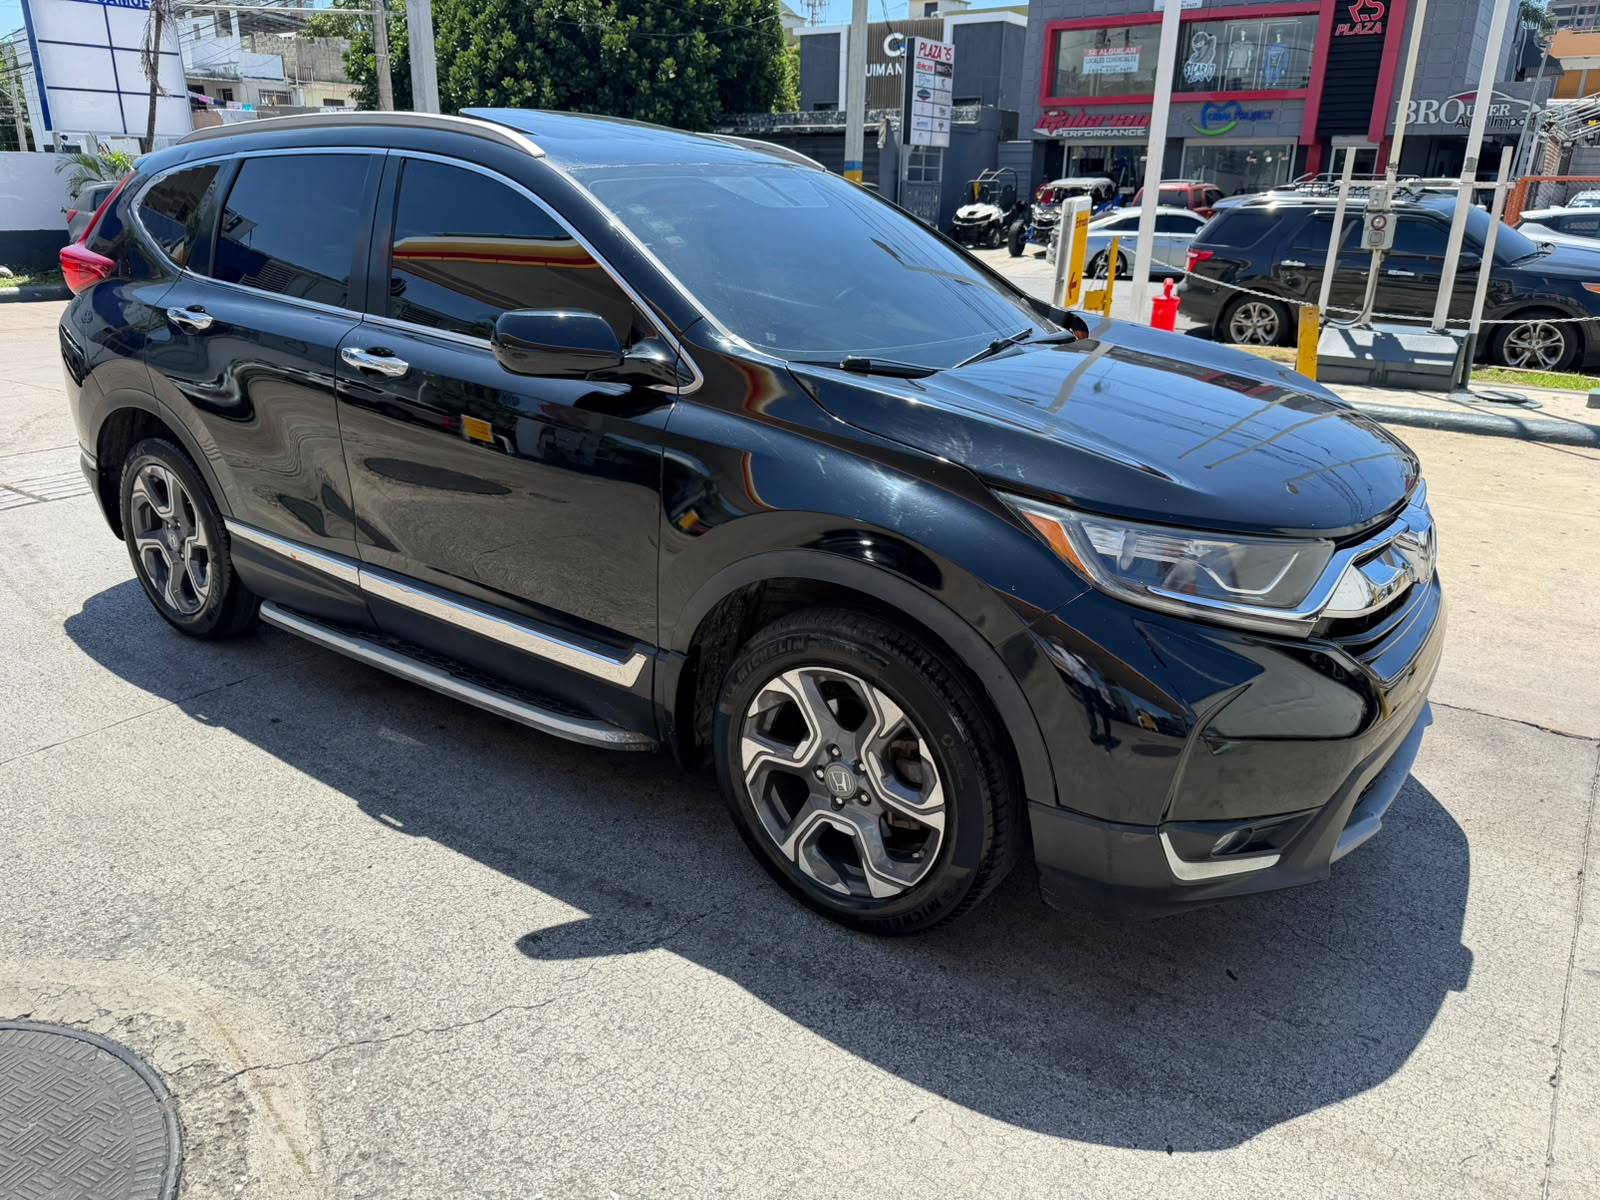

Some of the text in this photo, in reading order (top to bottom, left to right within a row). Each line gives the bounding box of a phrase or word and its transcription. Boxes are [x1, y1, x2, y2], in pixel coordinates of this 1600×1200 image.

[1334, 22, 1382, 36] PLAZA
[919, 42, 942, 59] PLAZA
[1098, 47, 1137, 55] ALQUILAN
[1490, 113, 1537, 130] Impot
[1051, 128, 1146, 137] PERFORMANCE
[735, 636, 807, 683] MICHELIN
